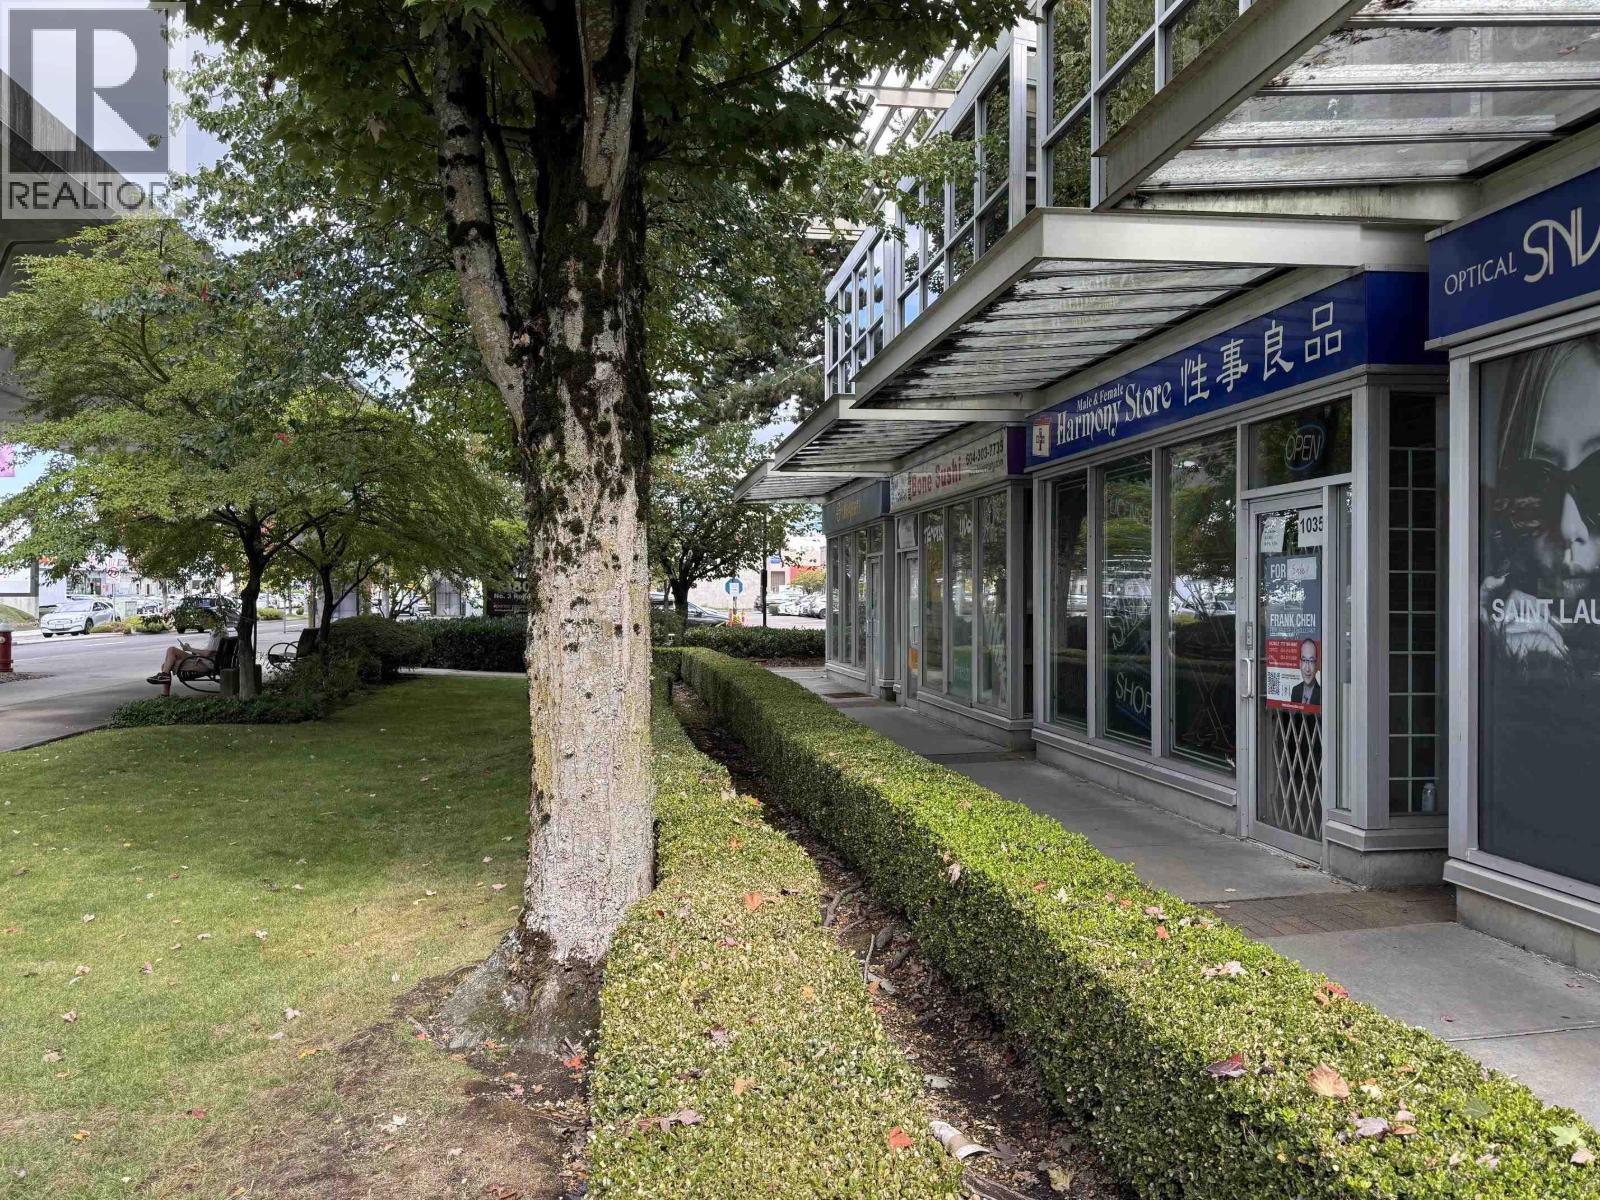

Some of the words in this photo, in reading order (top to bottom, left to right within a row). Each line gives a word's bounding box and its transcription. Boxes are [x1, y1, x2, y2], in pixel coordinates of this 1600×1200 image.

[1444, 251, 1518, 296] OPTICAL
[1181, 301, 1342, 406] 性事良品
[1076, 395, 1093, 411] Male
[1093, 392, 1099, 406] &
[1099, 383, 1124, 402] Female
[1056, 400, 1122, 446] Harmony
[1125, 381, 1172, 422] Store
[1285, 434, 1321, 461] OPEN
[935, 456, 961, 488] Sushi
[1300, 516, 1323, 533] 1035
[1270, 563, 1287, 579] FOR
[1270, 613, 1294, 627] FRANK
[1296, 613, 1316, 627] CHEN
[1491, 598, 1553, 624] SAINT
[1115, 671, 1152, 715] SHOP
